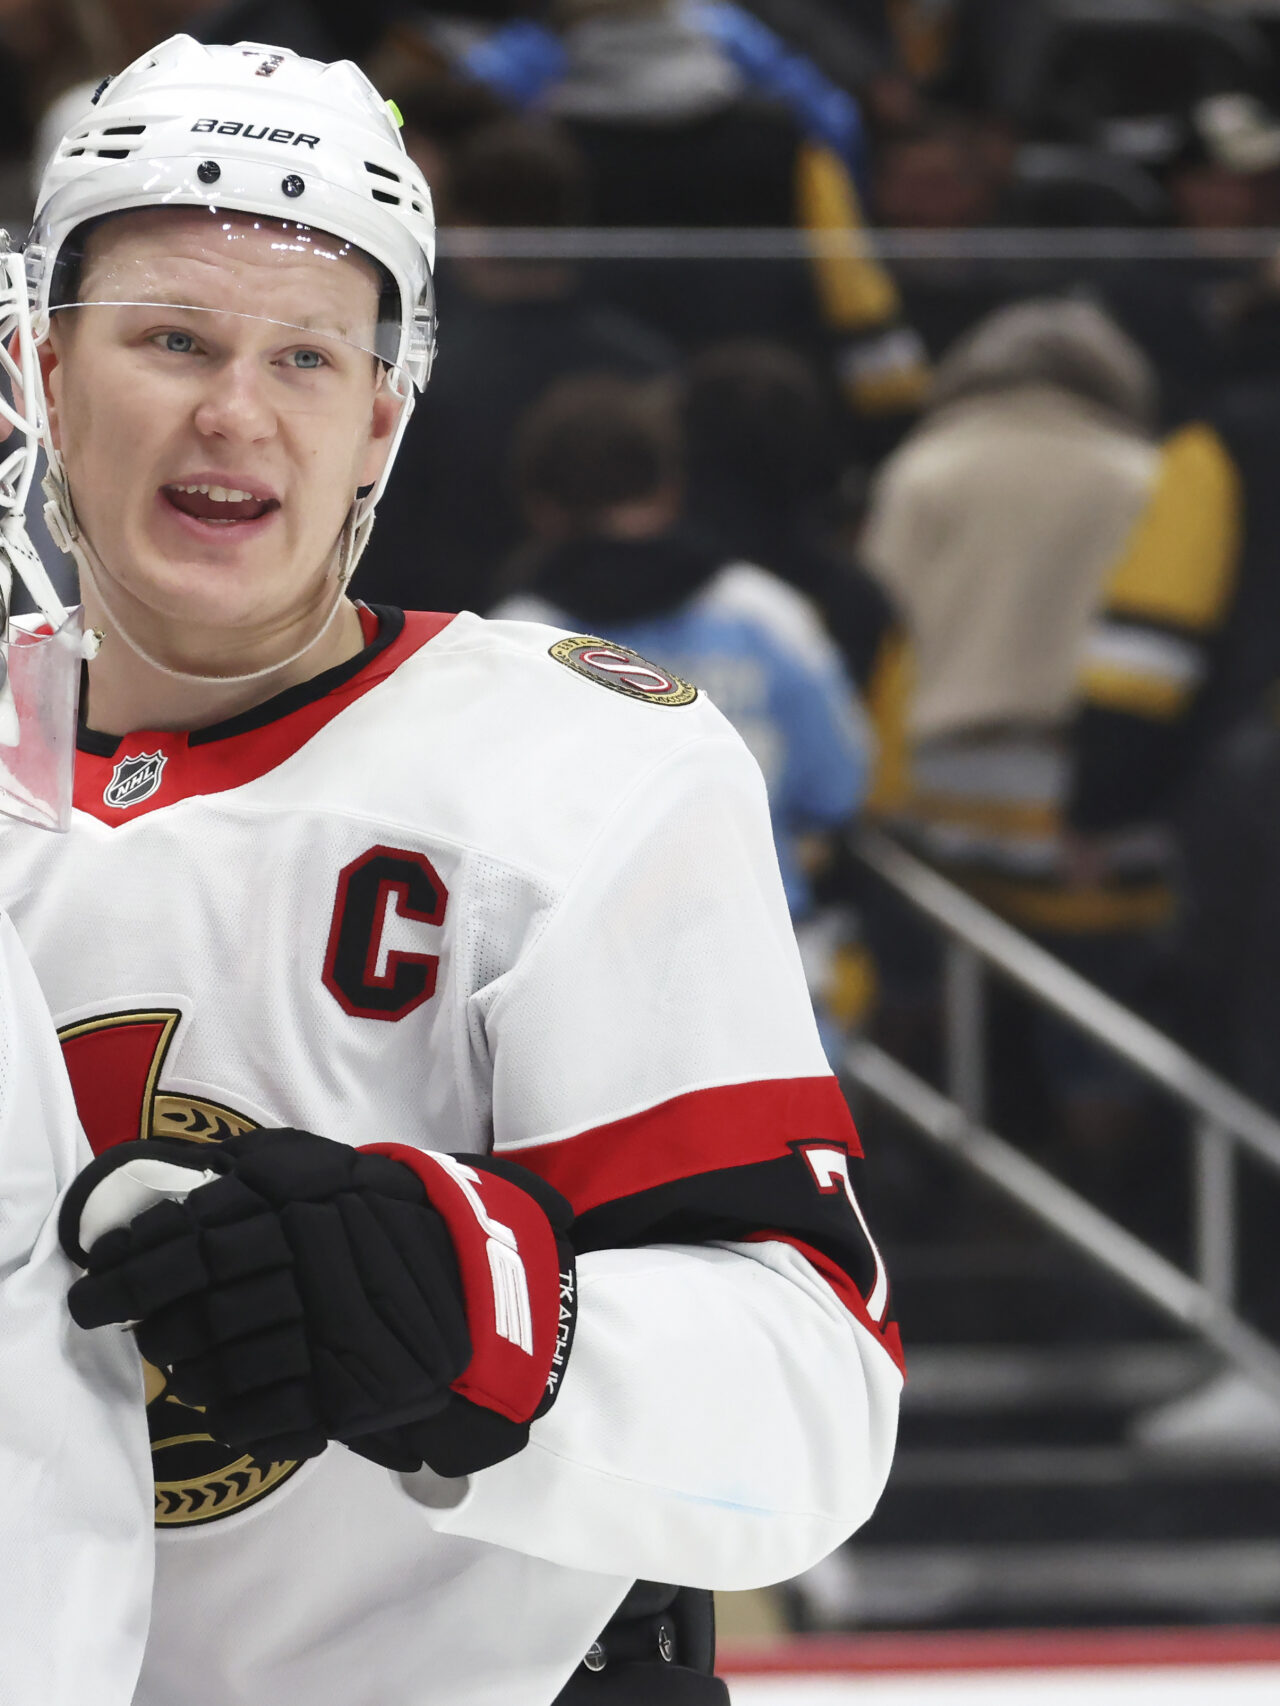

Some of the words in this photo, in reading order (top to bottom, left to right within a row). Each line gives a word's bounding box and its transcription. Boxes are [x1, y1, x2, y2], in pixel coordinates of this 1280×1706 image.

[116, 766, 153, 799] NHL
[321, 844, 449, 1022] C
[794, 1144, 890, 1324] 7
